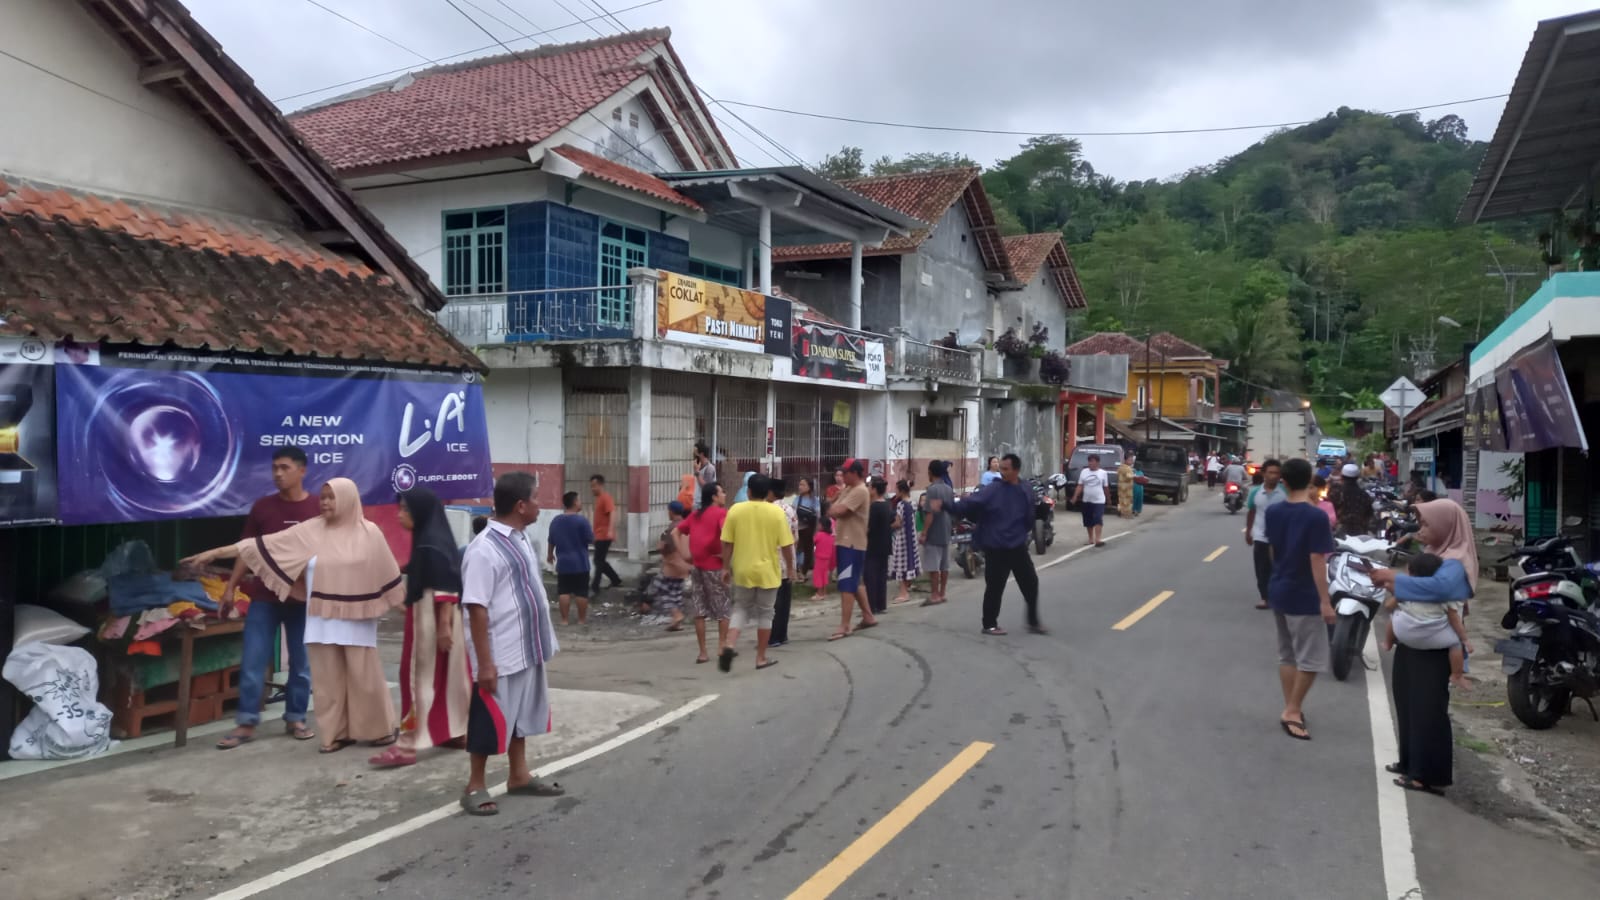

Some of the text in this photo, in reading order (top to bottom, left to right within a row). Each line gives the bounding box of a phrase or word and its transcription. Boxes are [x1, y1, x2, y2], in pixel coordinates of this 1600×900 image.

[670, 286, 703, 304] COKLAT
[705, 316, 728, 336] PASTI
[770, 317, 783, 328] TOKO
[168, 354, 196, 362] KARENA
[281, 414, 343, 427] A NEW
[259, 433, 364, 447] SENSATION
[446, 442, 469, 453] ICE
[313, 452, 344, 464] ICE
[418, 473, 478, 483] PURPLEBOOST
